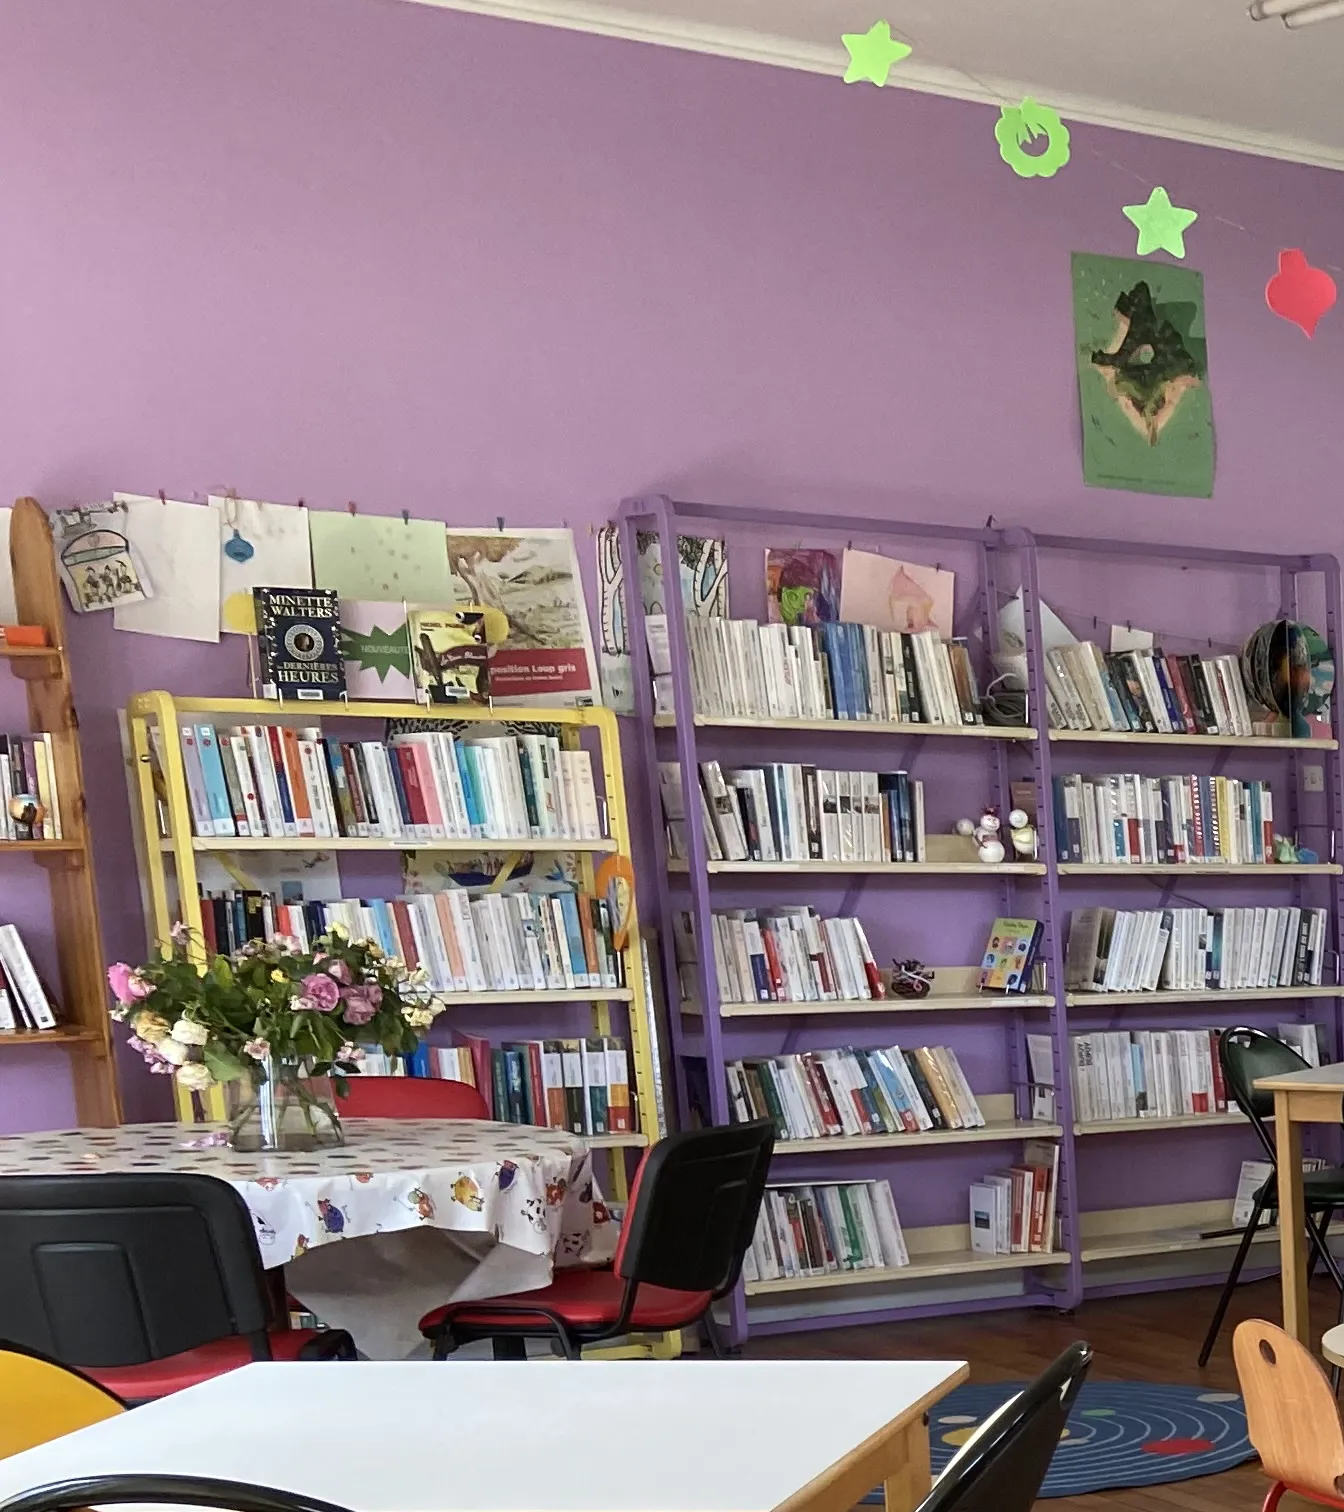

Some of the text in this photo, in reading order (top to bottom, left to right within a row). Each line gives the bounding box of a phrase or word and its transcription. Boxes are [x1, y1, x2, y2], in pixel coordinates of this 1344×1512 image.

[269, 594, 333, 608] MINETTE
[270, 605, 333, 618] WALTERS
[277, 670, 339, 684] HEURES
